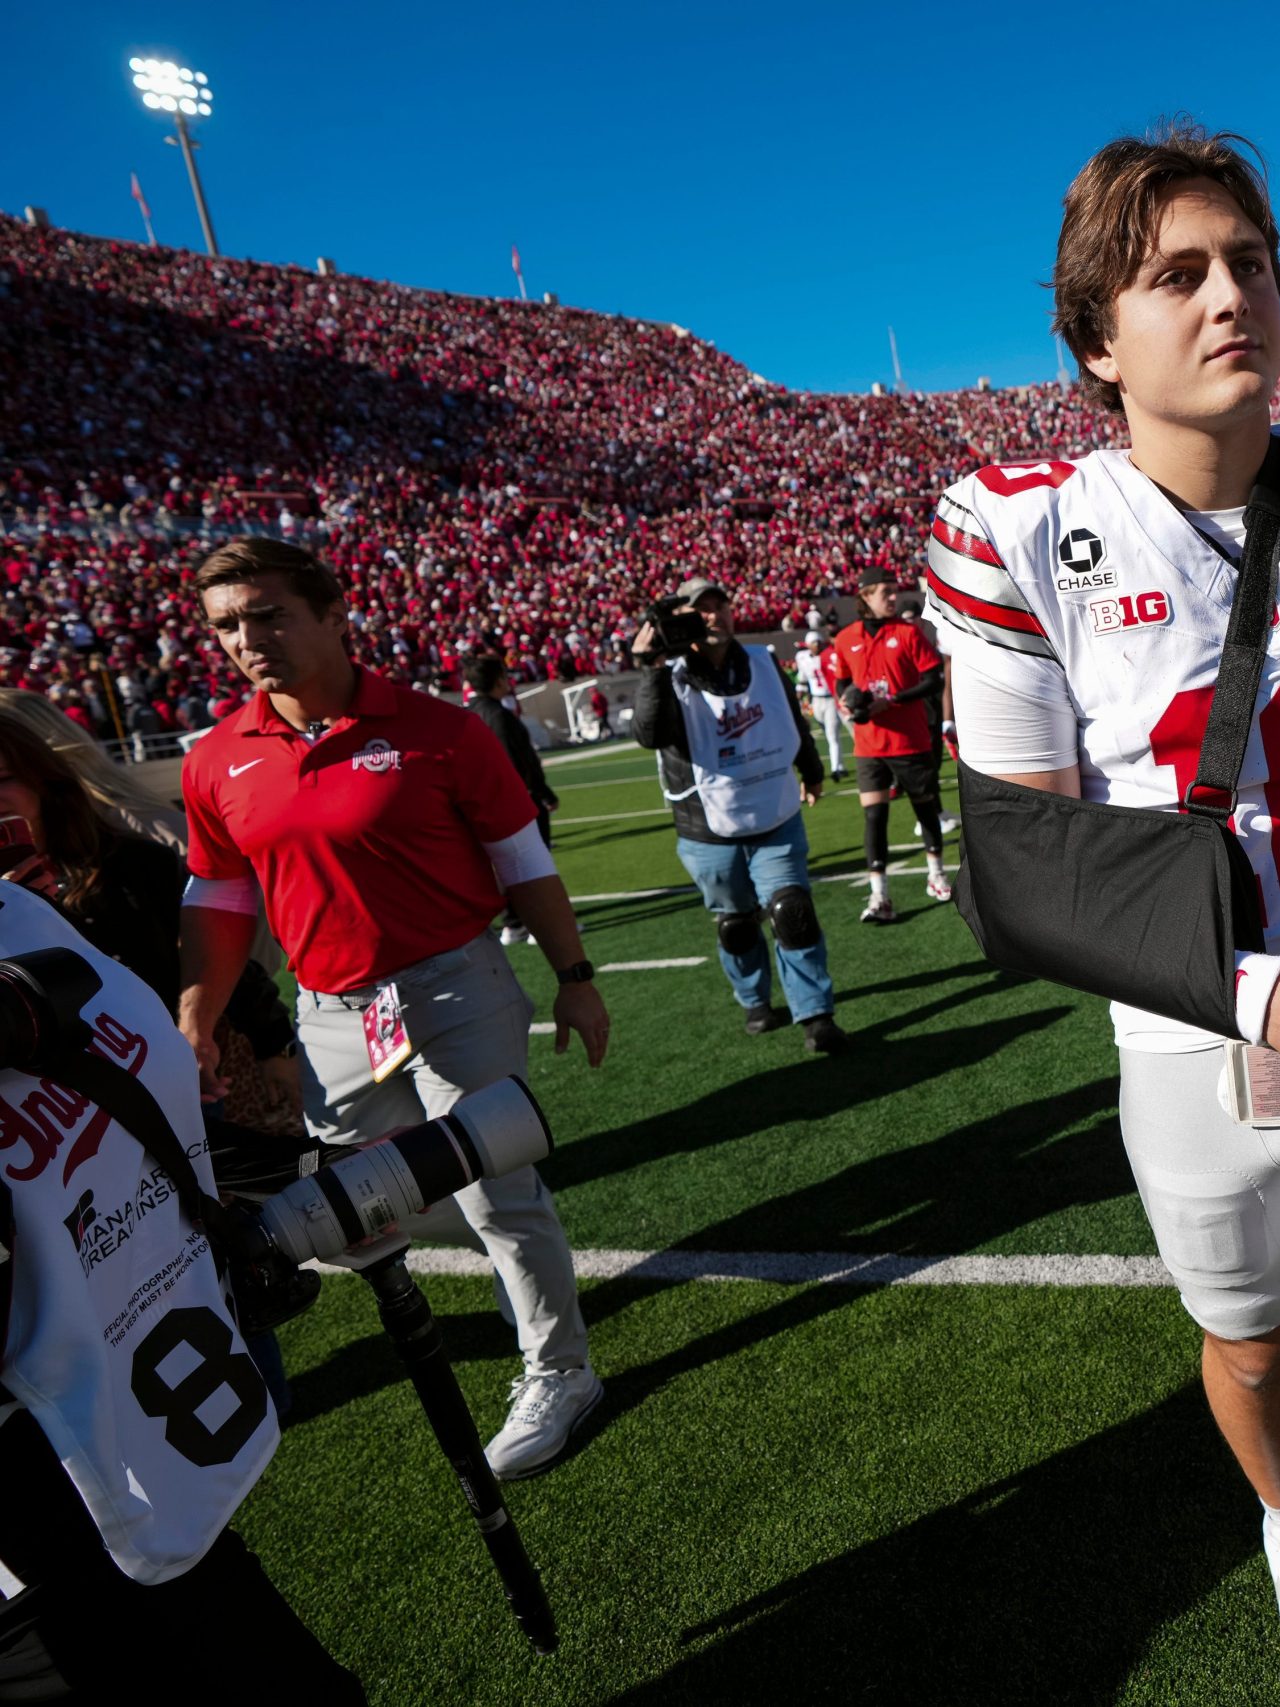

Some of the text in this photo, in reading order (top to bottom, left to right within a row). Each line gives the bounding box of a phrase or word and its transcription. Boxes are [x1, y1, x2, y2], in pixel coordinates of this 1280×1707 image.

[1057, 572, 1115, 591] CHASE
[110, 1329, 126, 1348] THIS
[125, 1310, 140, 1330] VEST
[139, 1288, 162, 1312] MUST
[163, 1277, 176, 1292] BE
[175, 1256, 194, 1280] WORN
[131, 1306, 268, 1467] 8
